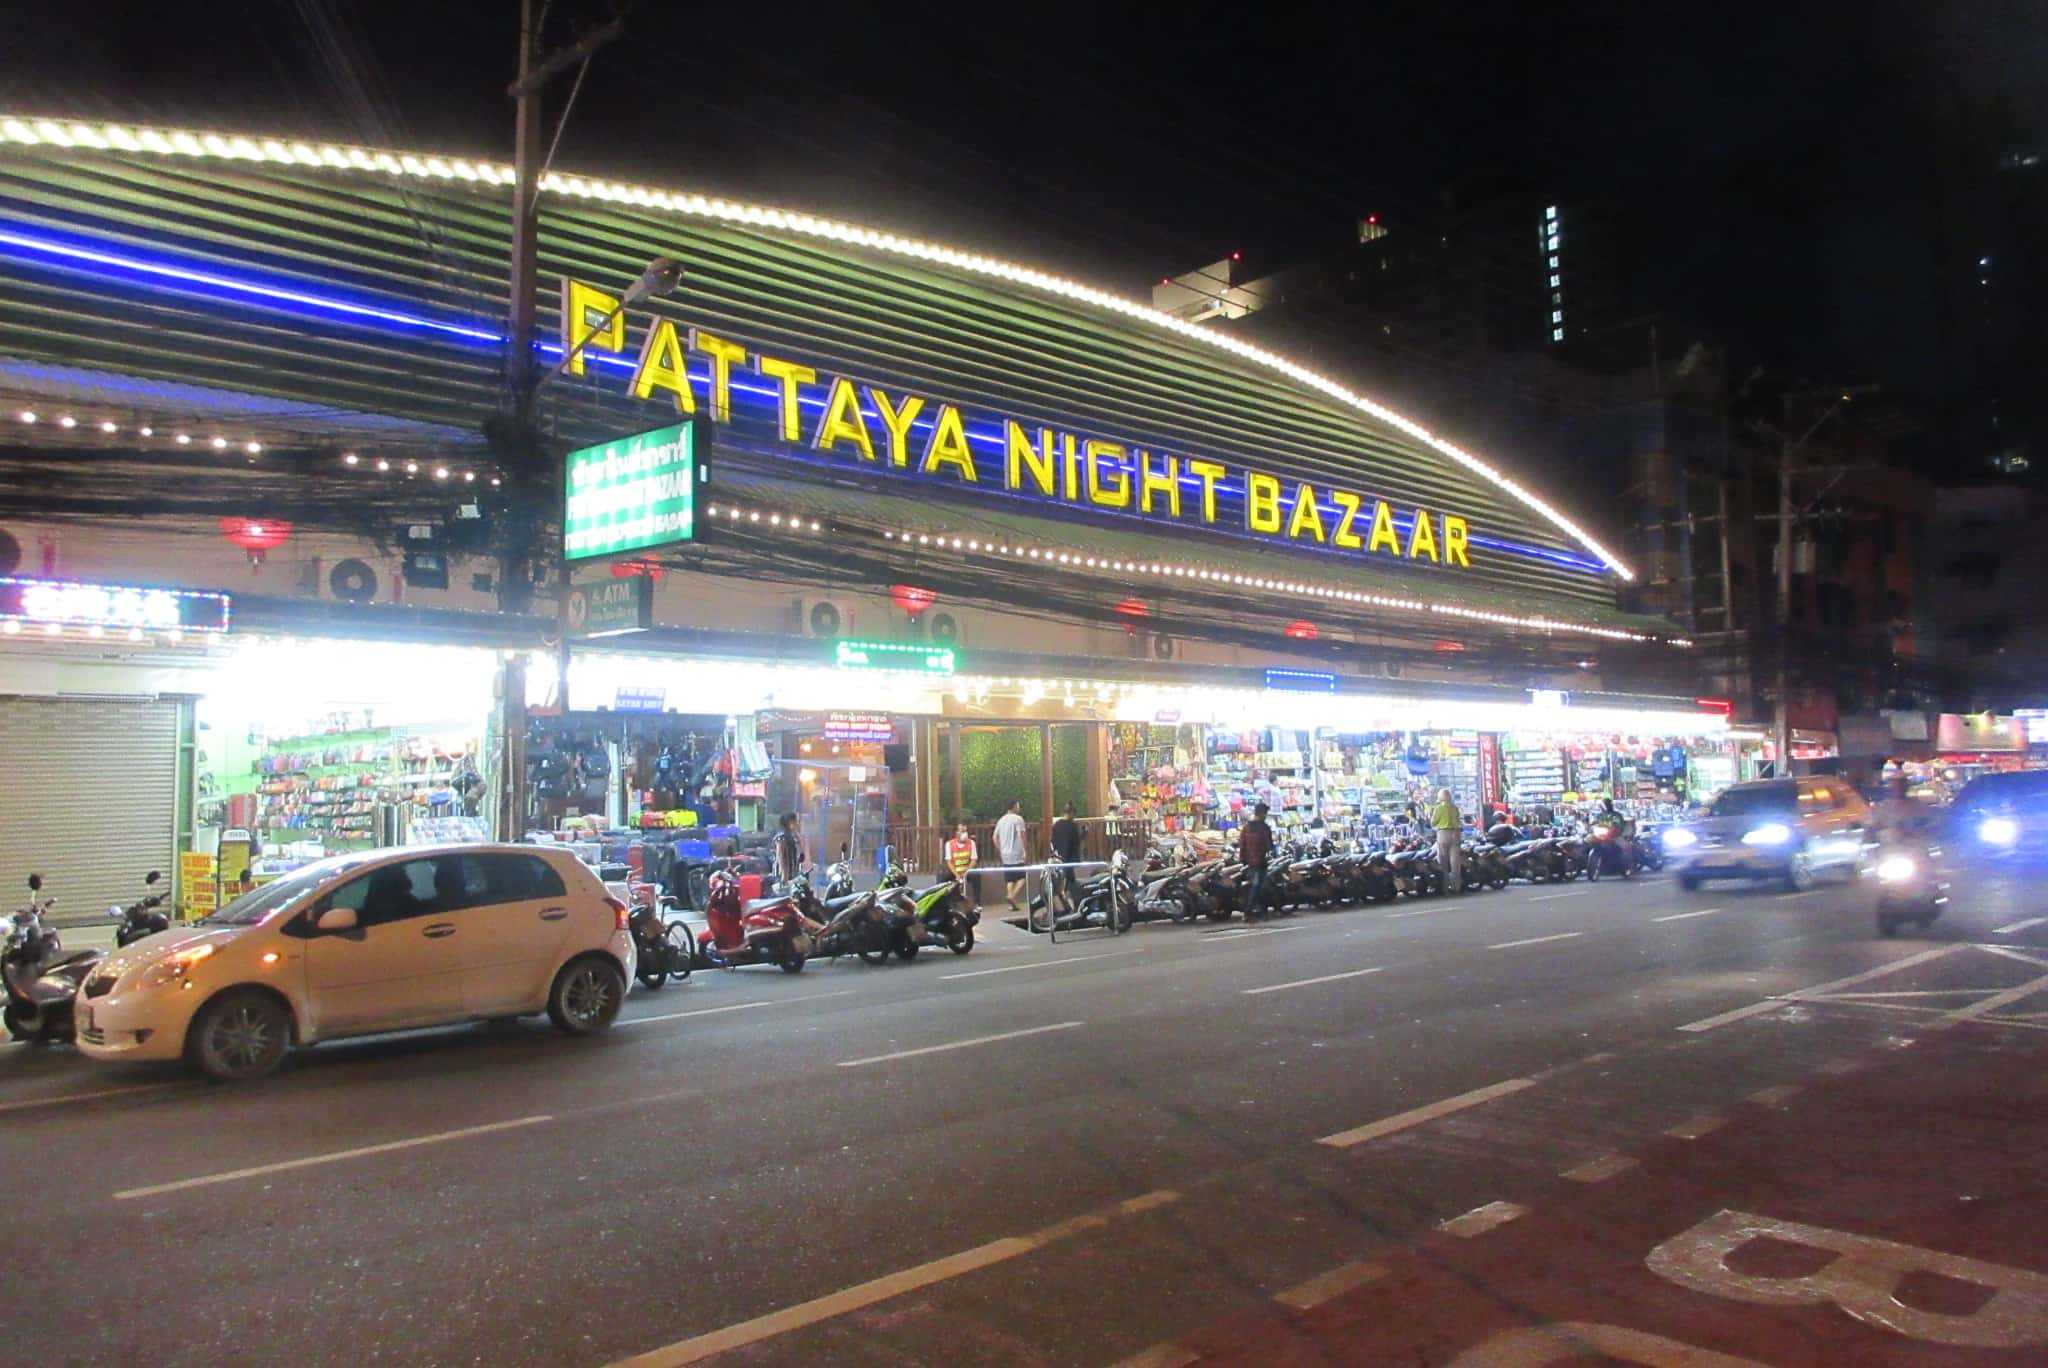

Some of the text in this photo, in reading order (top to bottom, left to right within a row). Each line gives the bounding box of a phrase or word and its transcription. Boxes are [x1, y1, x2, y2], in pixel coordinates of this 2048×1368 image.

[561, 277, 1471, 568] PATTAYA NIGHT BAZAAR
[603, 582, 630, 604] ATM
